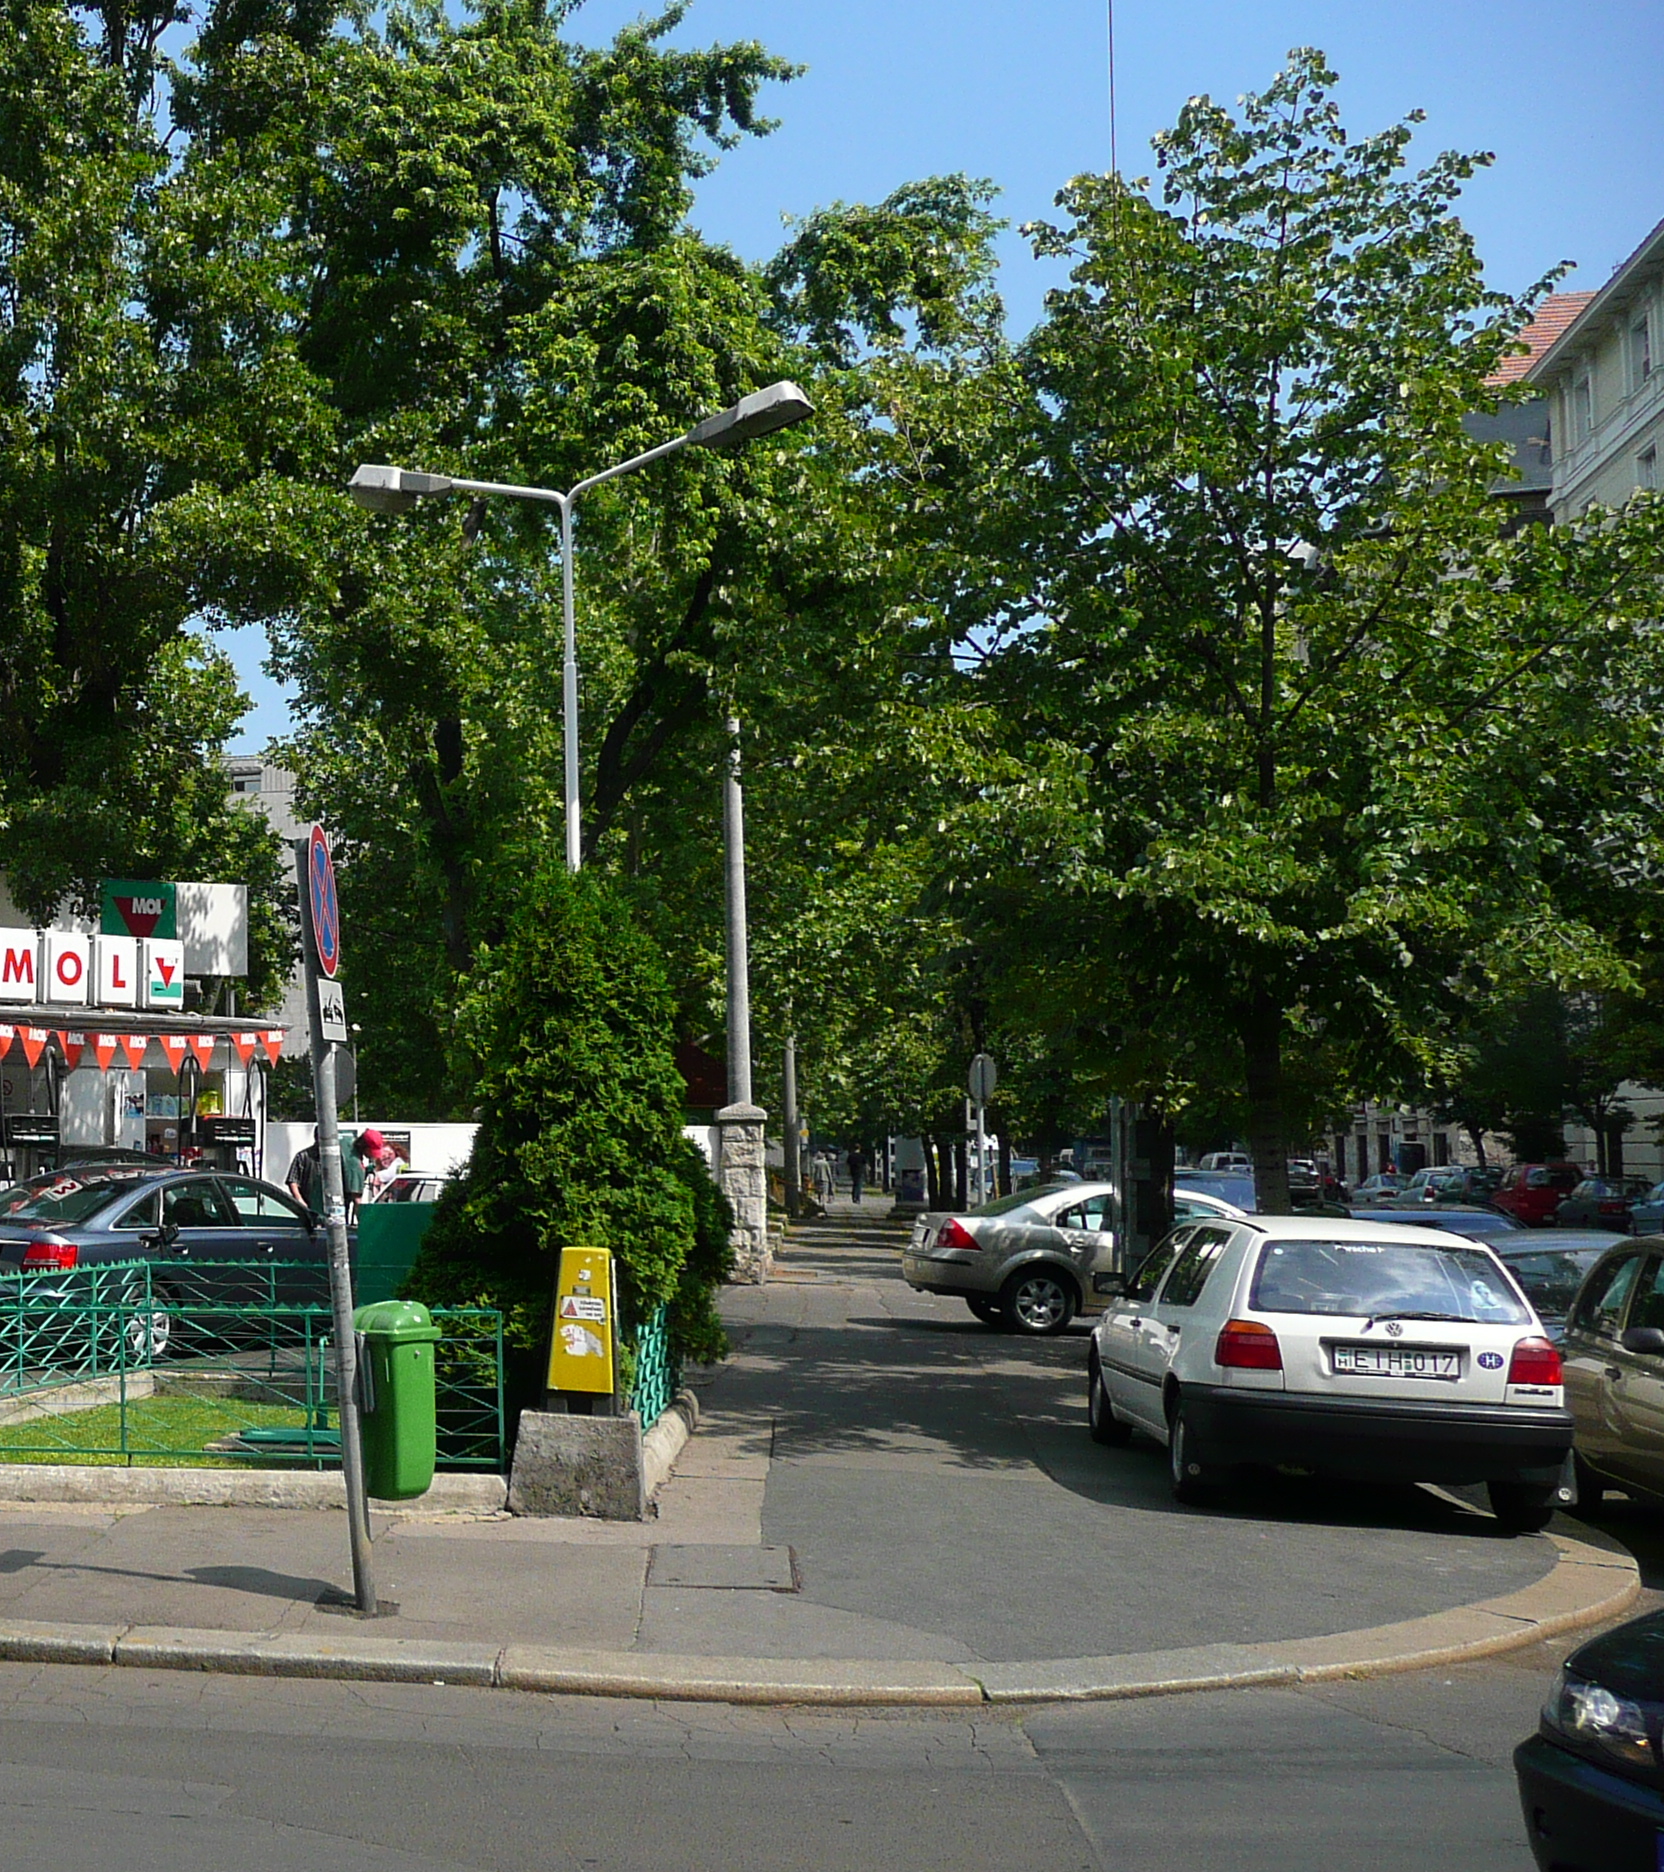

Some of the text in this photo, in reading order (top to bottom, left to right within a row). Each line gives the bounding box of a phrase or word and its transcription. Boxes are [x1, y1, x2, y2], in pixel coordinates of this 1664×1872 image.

[132, 897, 162, 915] MOL
[2, 948, 126, 989] MOL
[28, 1028, 47, 1042] MOL
[67, 1032, 85, 1046] MOL
